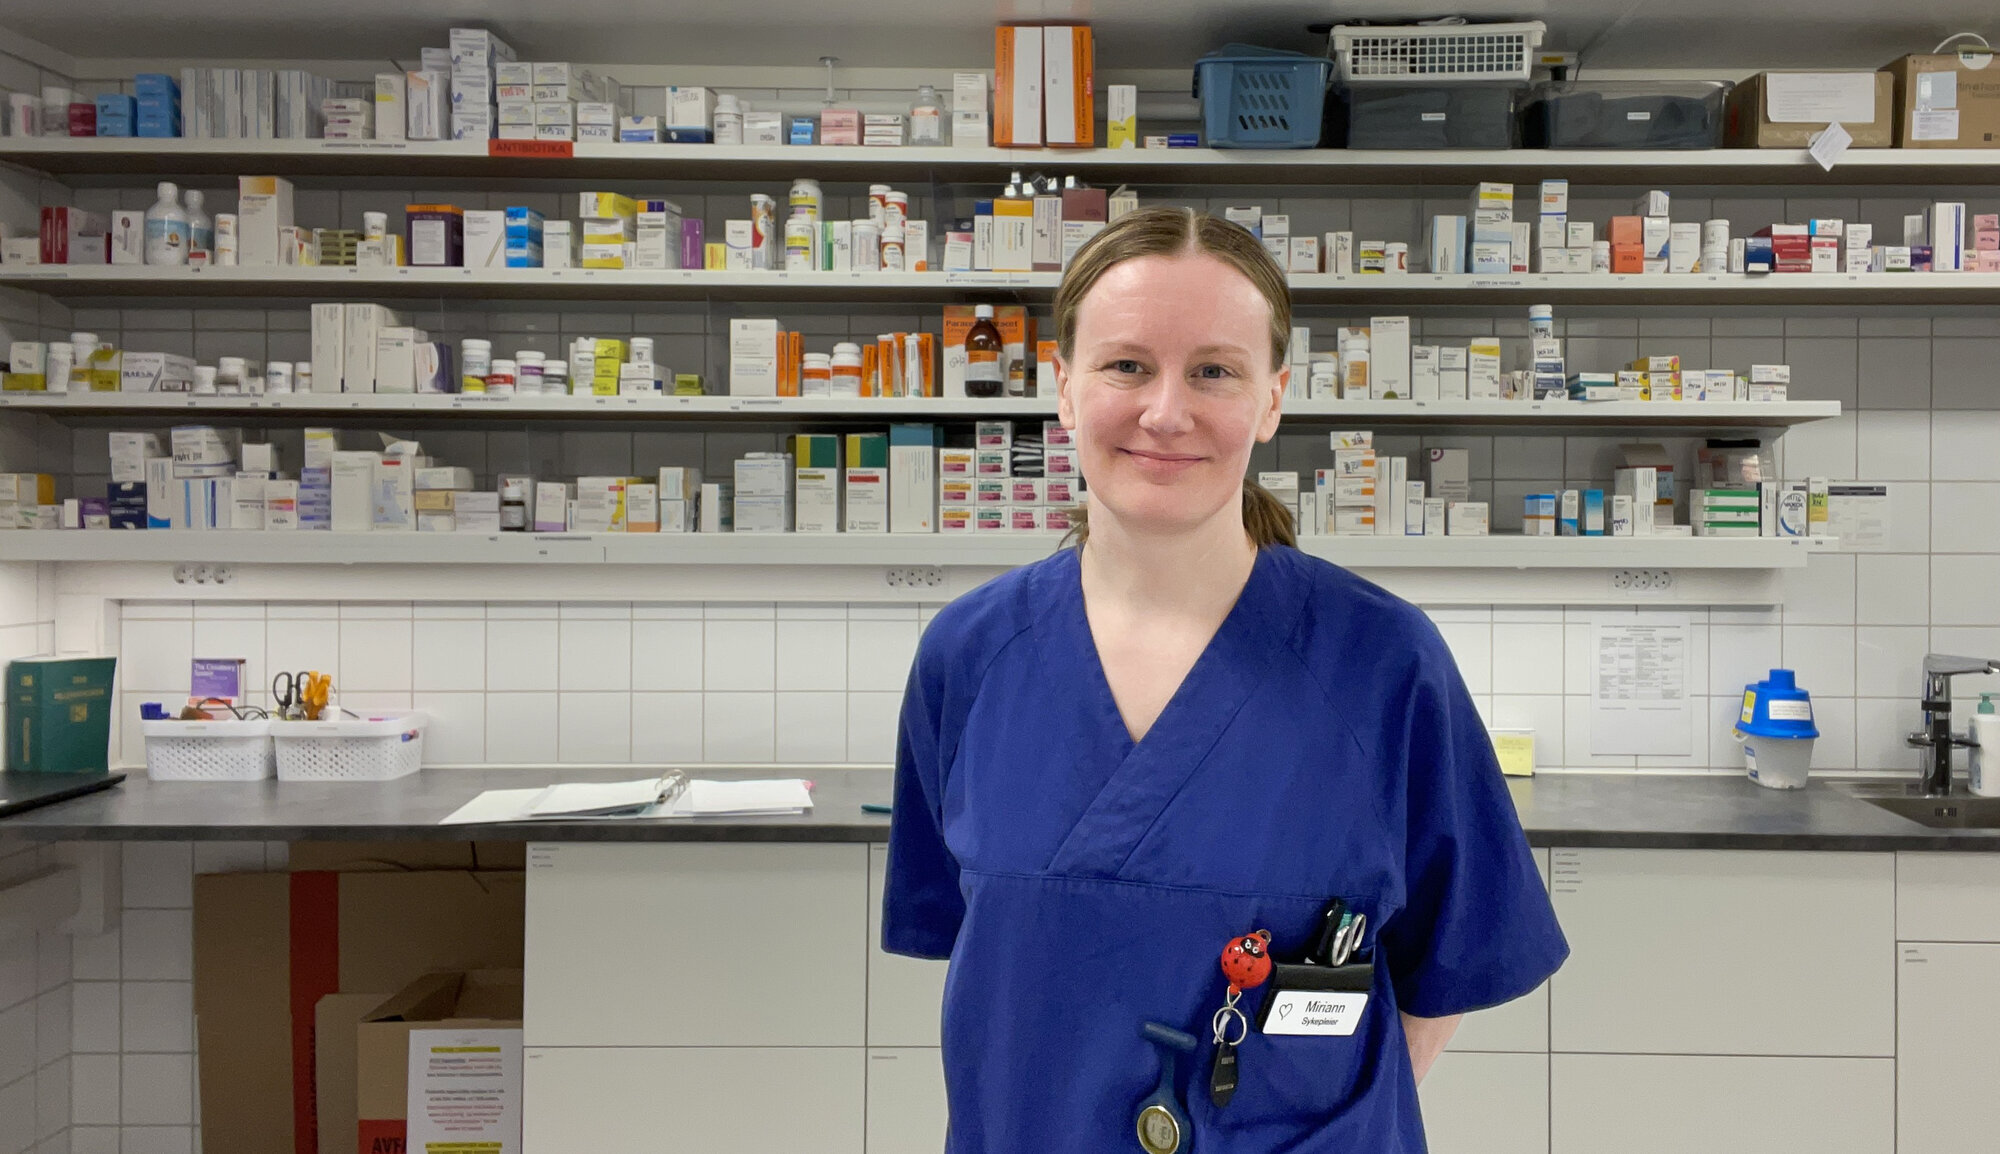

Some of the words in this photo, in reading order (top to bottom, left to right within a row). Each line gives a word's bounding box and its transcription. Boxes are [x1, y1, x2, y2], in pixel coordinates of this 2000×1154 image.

[496, 143, 566, 153] ANTIBIOTIKA
[1305, 1000, 1346, 1013] Miriann
[1301, 1016, 1339, 1026] Sykepleier
[372, 1137, 407, 1154] AVF
